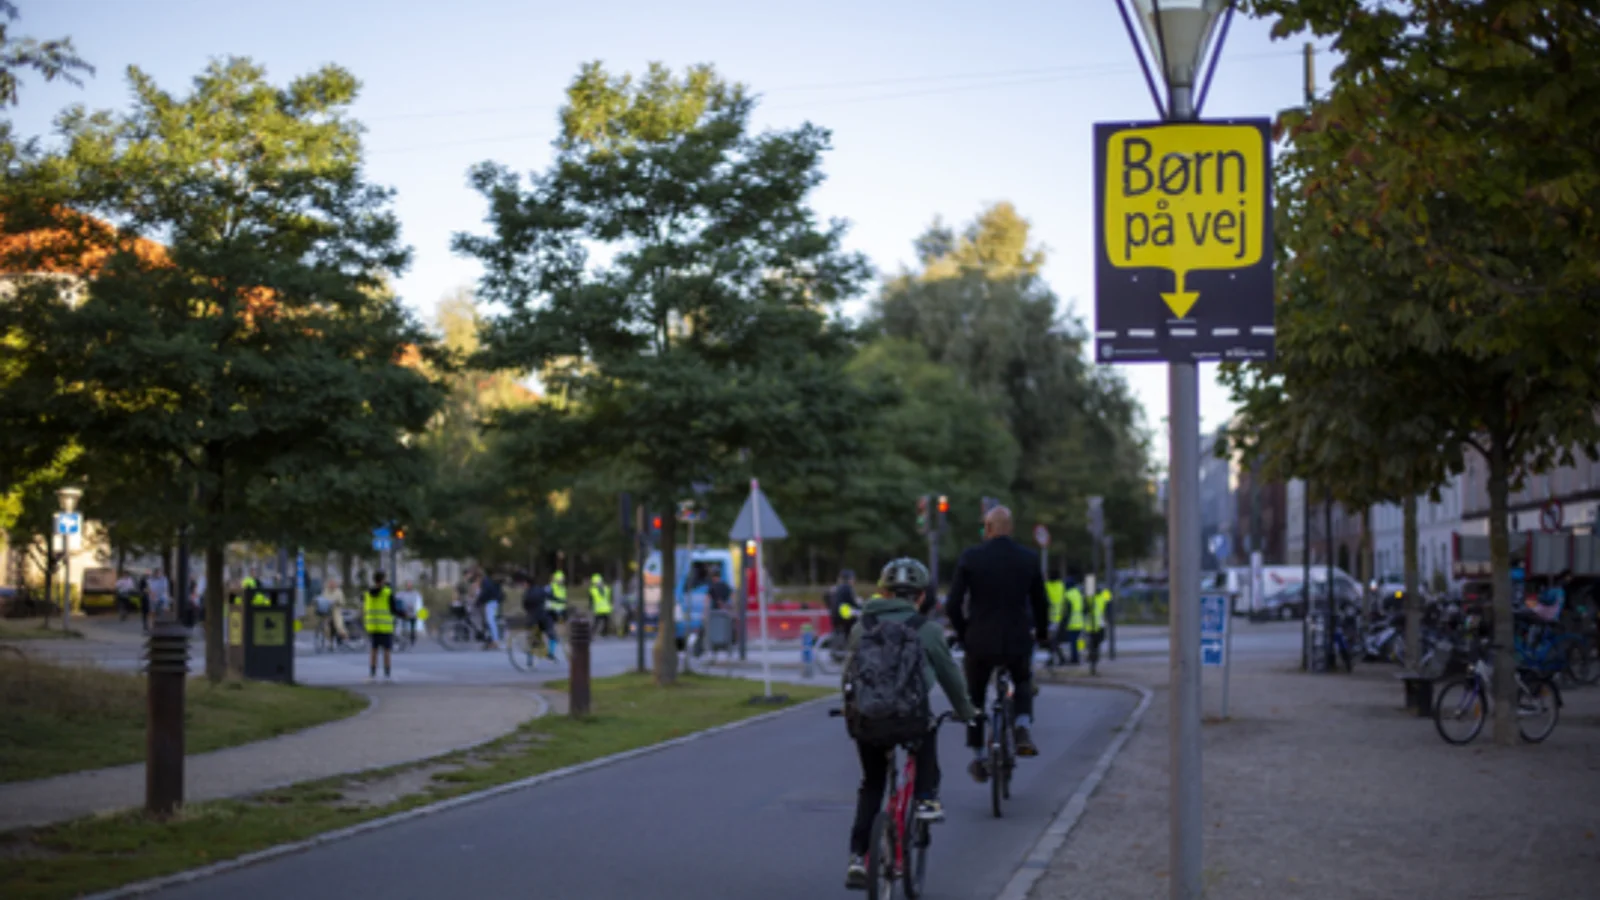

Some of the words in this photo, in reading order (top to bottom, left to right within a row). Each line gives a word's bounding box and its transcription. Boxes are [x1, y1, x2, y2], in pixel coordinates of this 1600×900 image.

[1122, 137, 1246, 197] Børn
[1125, 199, 1175, 261] på
[1187, 199, 1247, 260] vej
